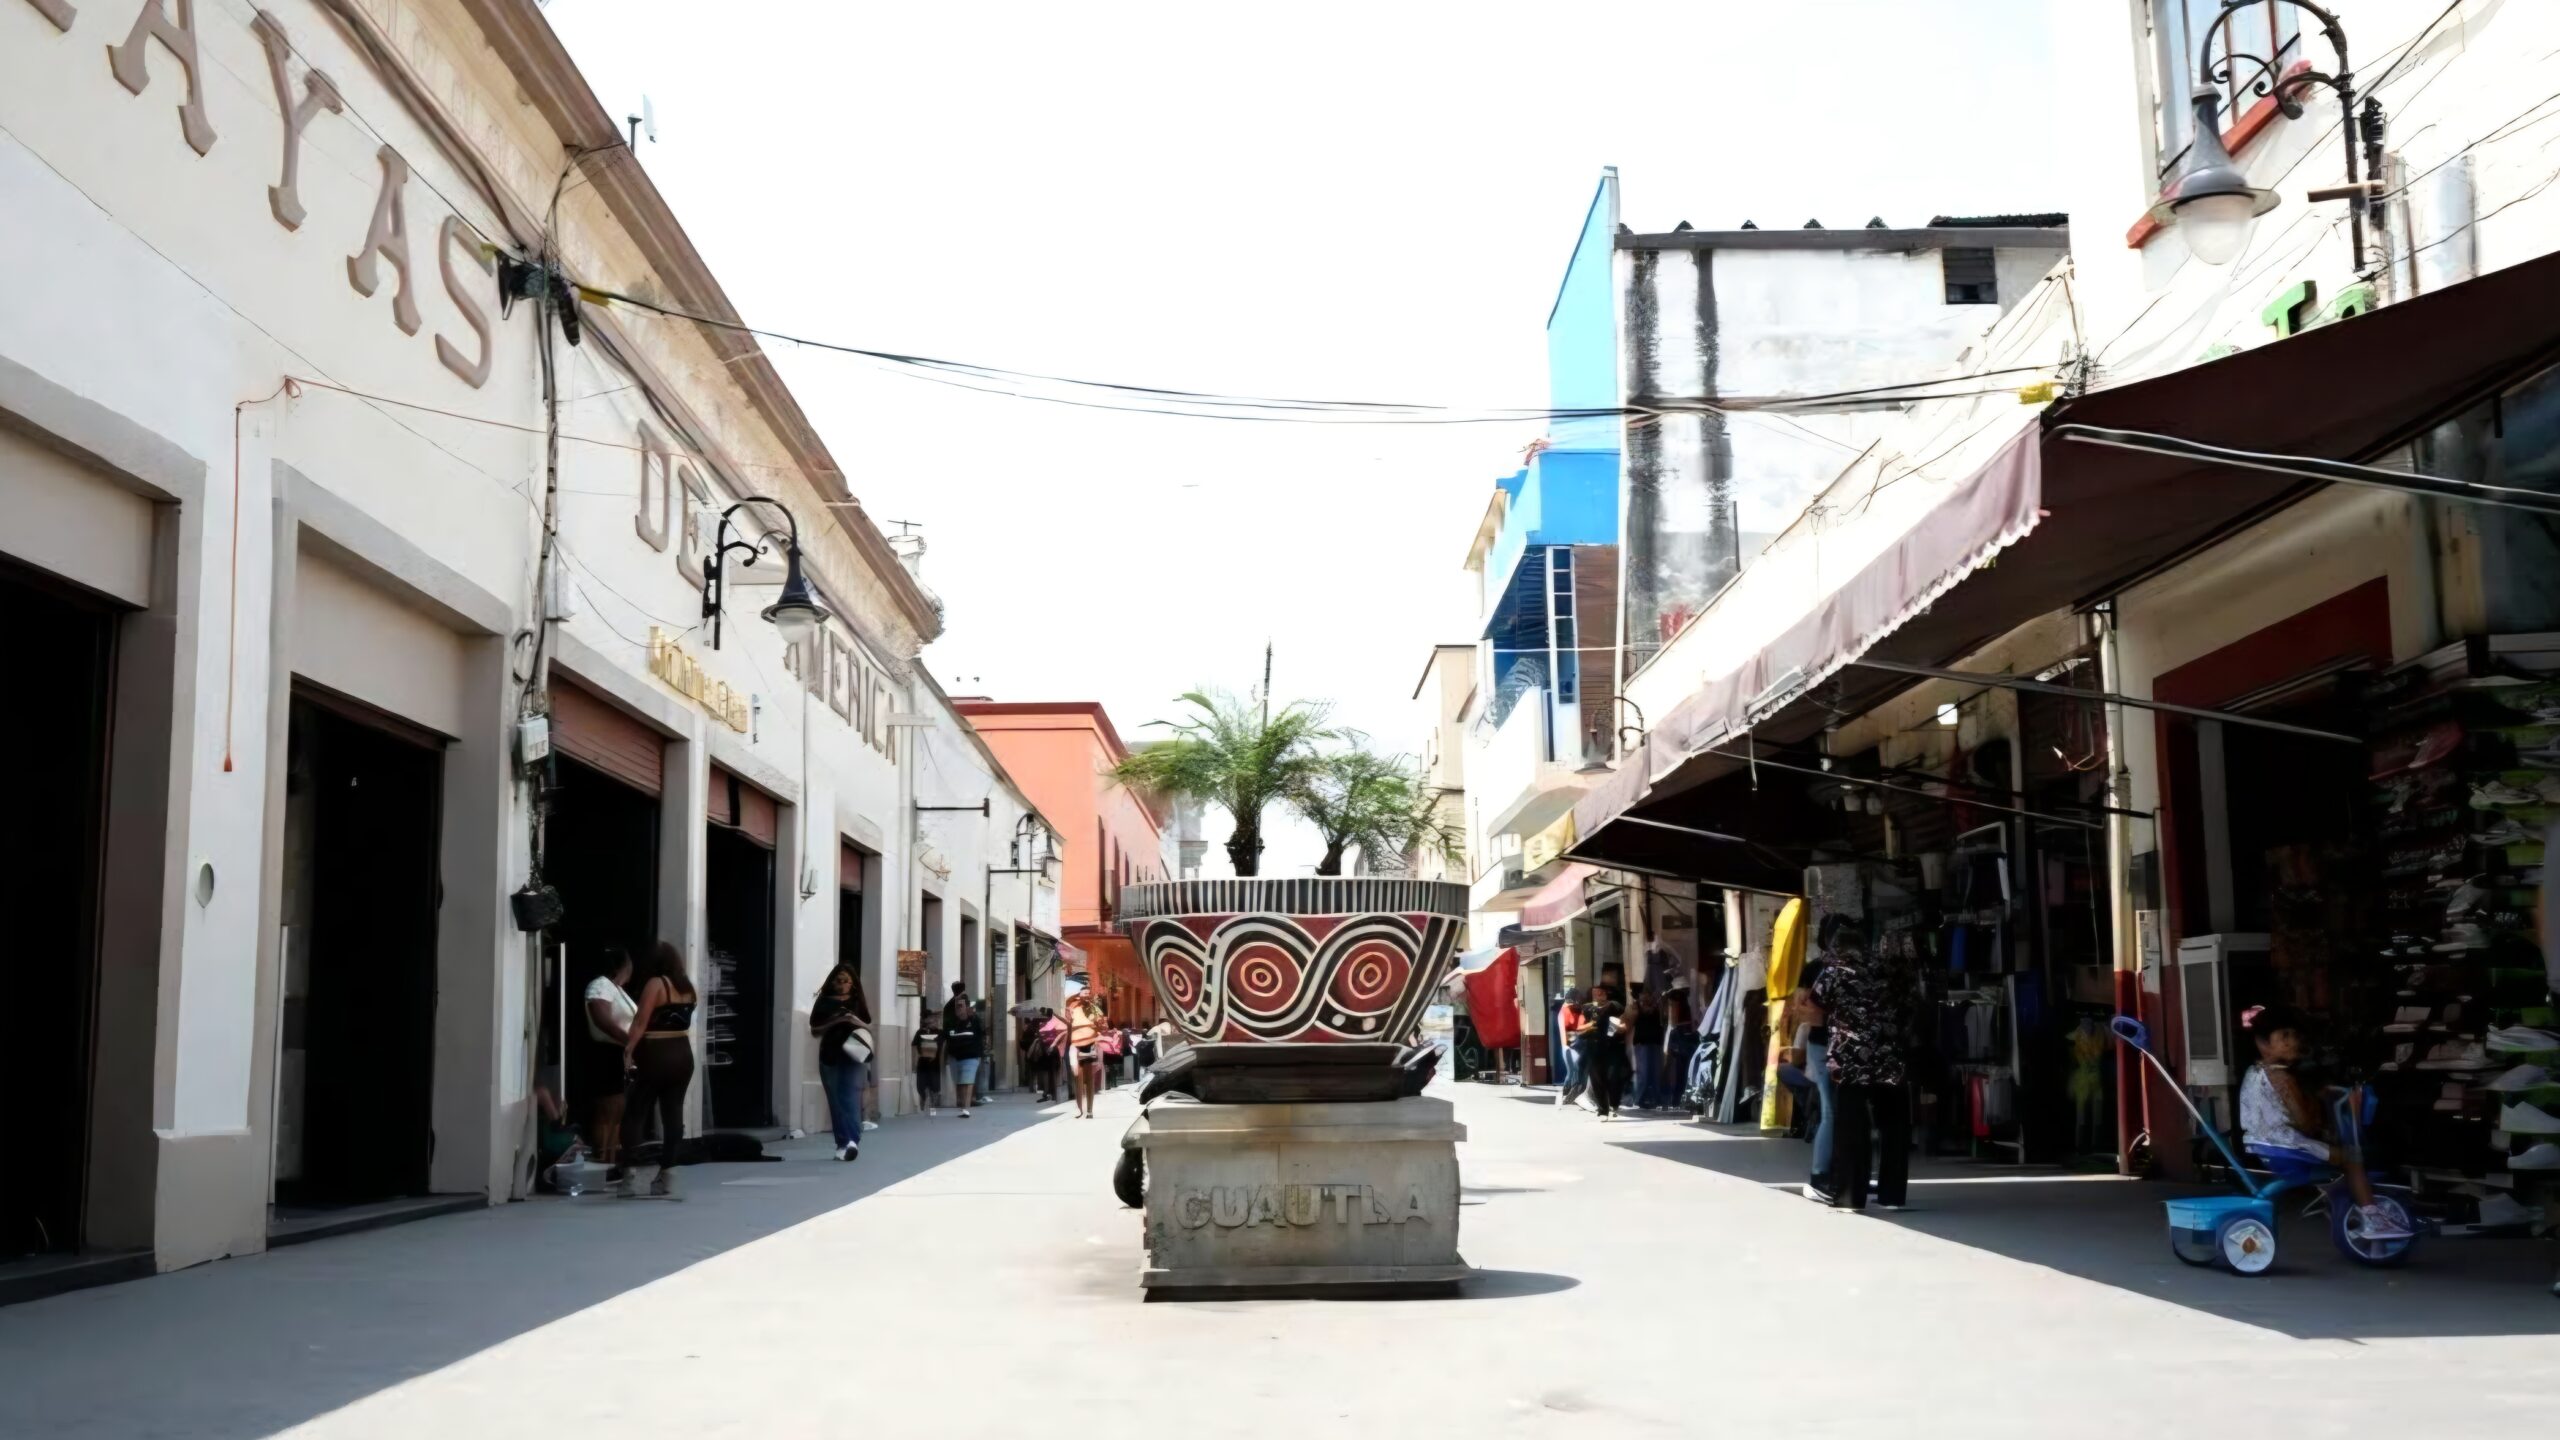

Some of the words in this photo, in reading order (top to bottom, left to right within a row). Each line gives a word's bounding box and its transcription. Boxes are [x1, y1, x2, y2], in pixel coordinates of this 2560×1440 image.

[25, 0, 493, 389] AYAS
[635, 418, 708, 593] DE
[1174, 1183, 1432, 1230] CUAUTLA
